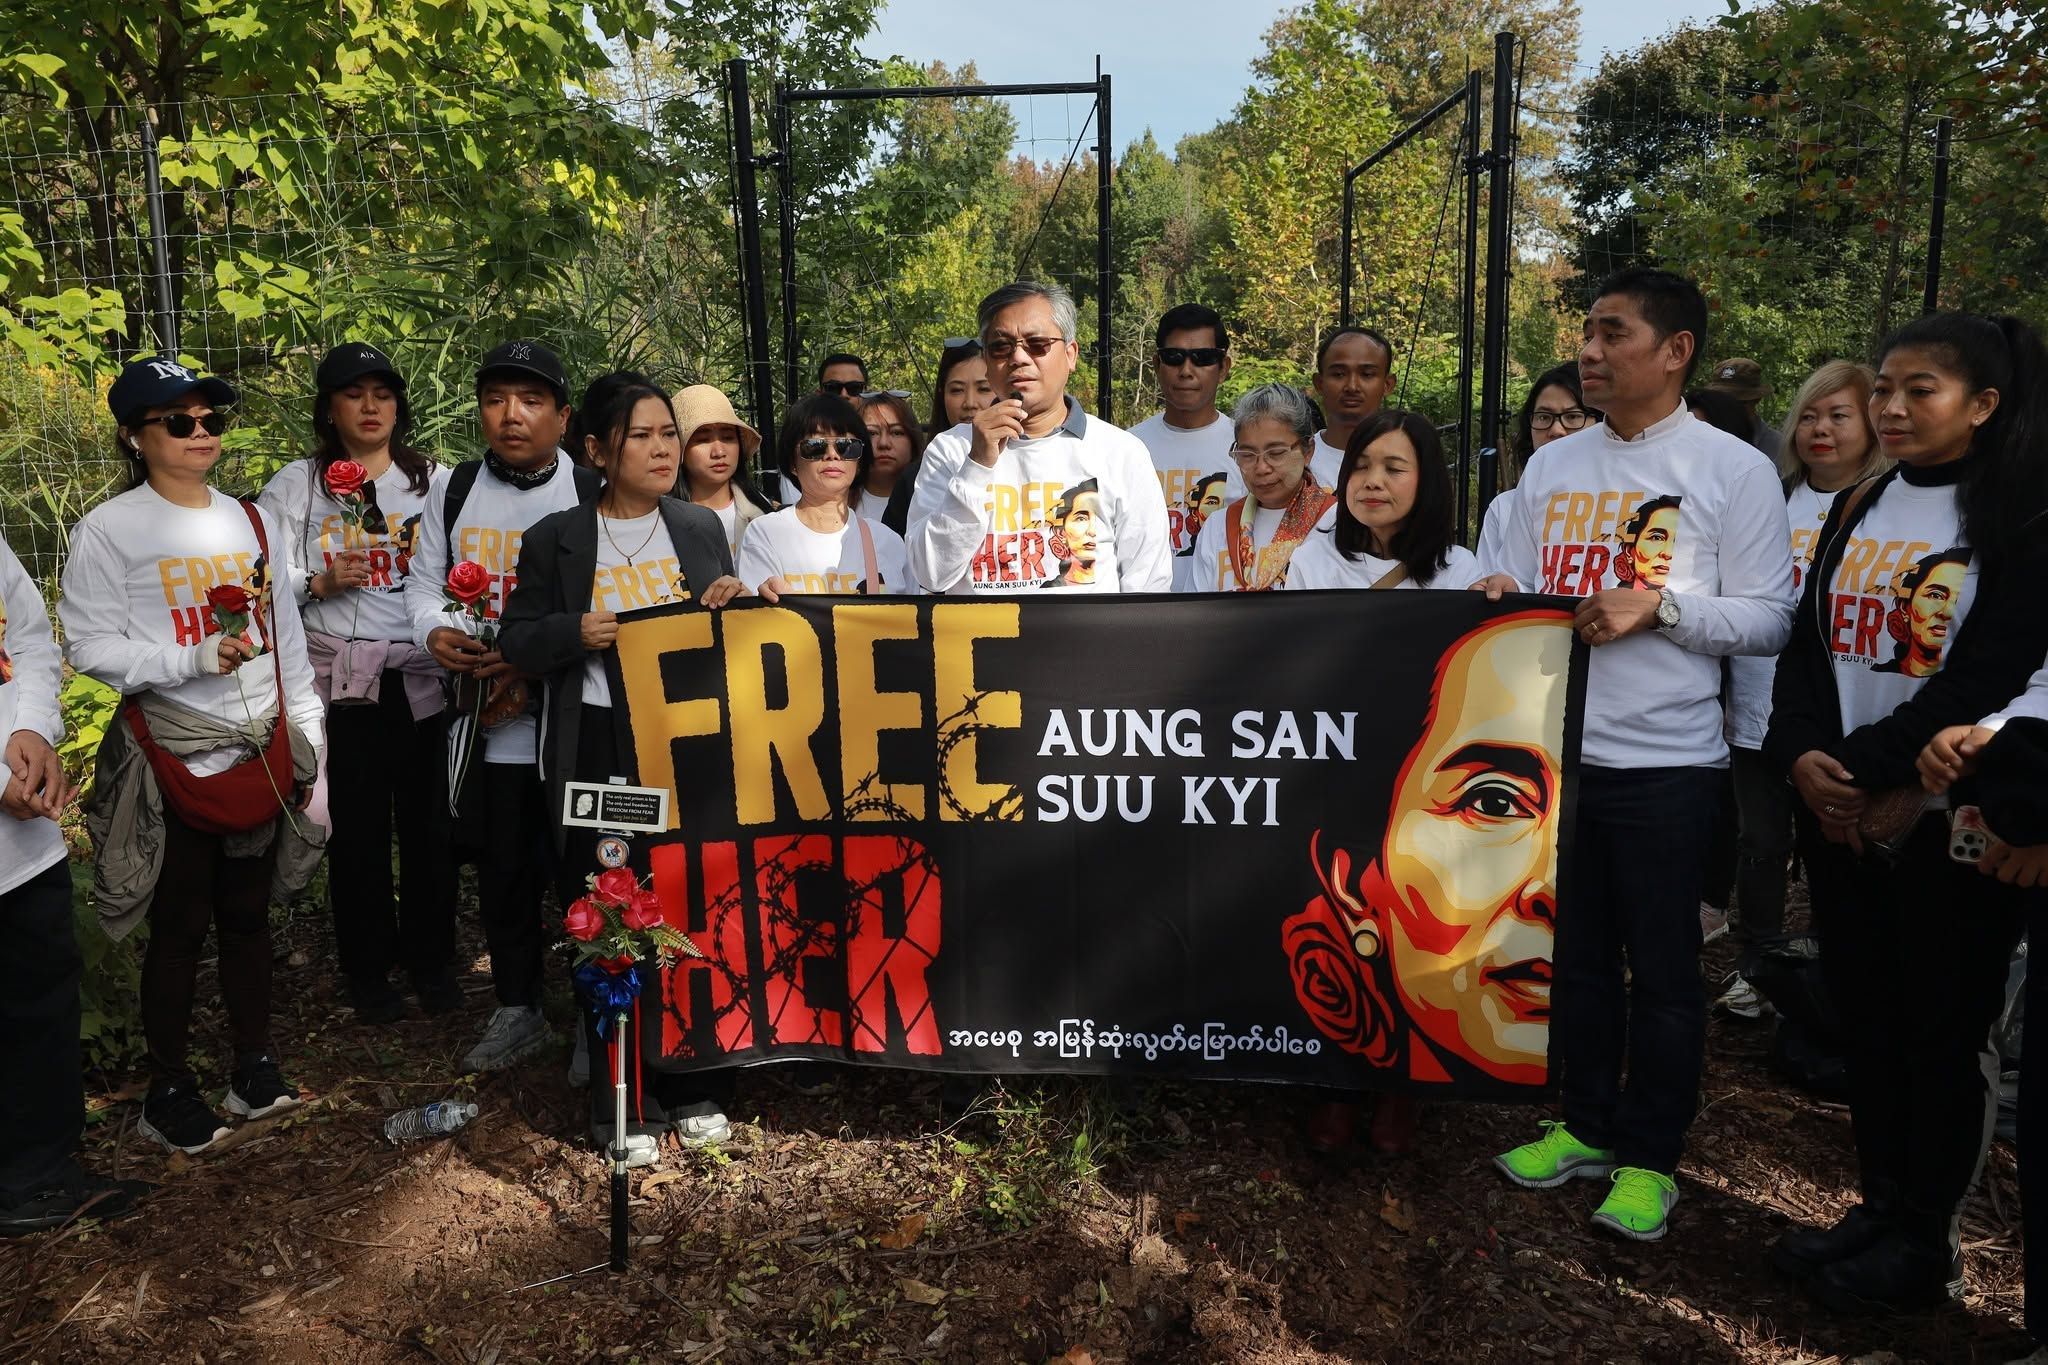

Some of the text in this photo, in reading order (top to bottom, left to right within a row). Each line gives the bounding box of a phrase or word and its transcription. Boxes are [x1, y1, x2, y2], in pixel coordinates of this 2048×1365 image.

[1542, 491, 1645, 543] FREE
[973, 531, 1047, 583] HER
[1539, 544, 1611, 596] HER
[592, 557, 692, 612] FREE
[1840, 654, 1860, 663] SUU
[616, 602, 1024, 829] FREE
[1036, 708, 1359, 761] AUNG SAN
[1036, 774, 1281, 826] SUU KYI
[650, 834, 943, 1057] HER
[949, 1029, 1023, 1058] အမေစု
